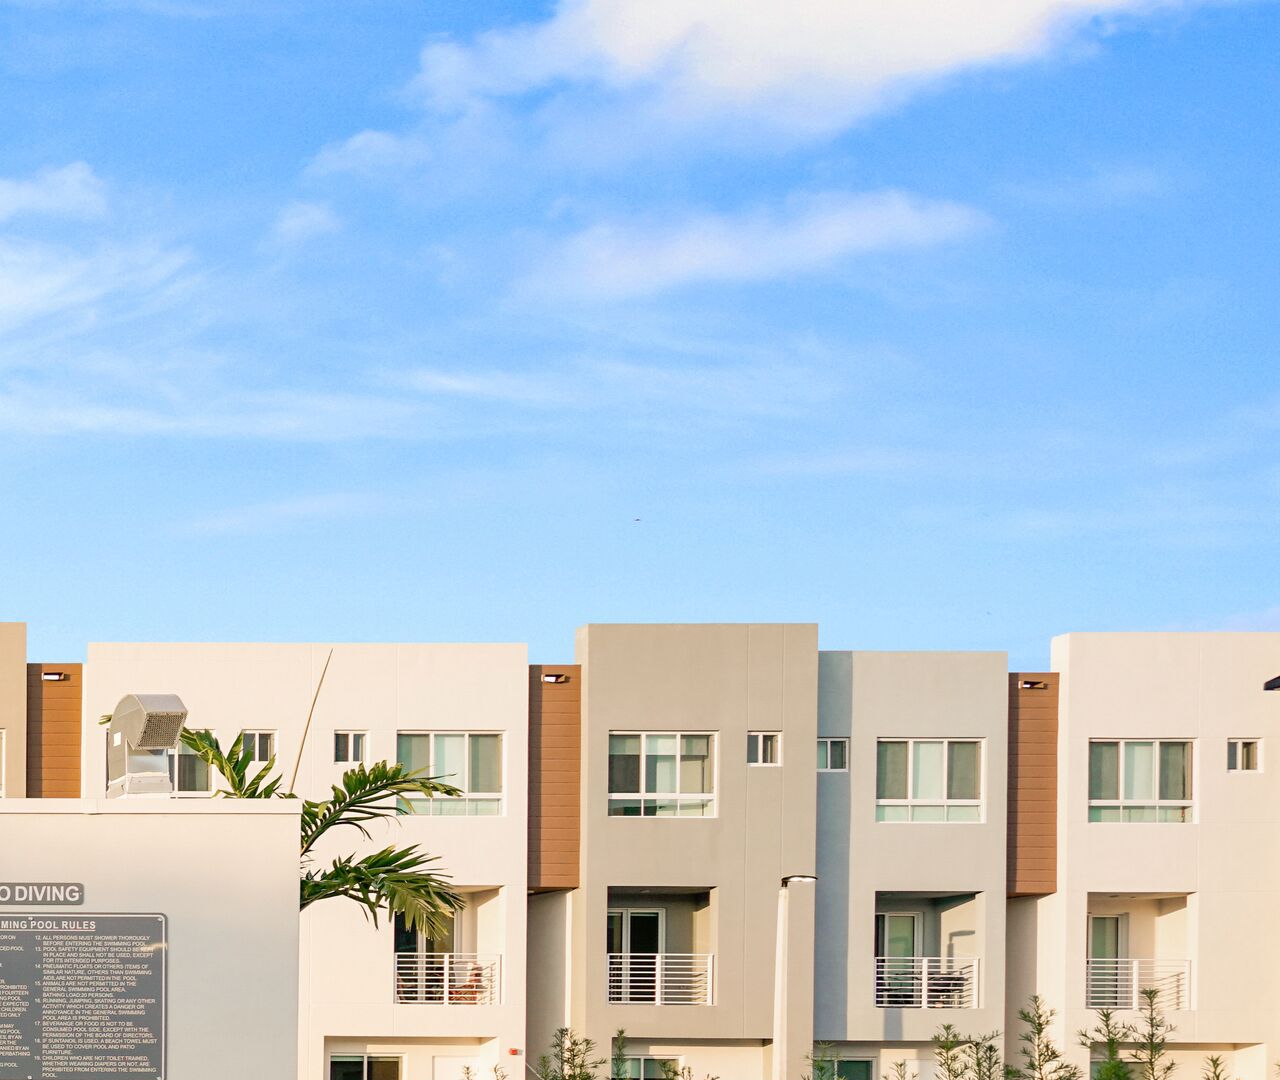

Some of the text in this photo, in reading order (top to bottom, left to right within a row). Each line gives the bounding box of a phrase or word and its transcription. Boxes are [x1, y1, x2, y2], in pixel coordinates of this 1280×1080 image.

[15, 887, 80, 902] DIVING
[30, 921, 59, 929] POOL
[62, 921, 96, 930] RULES
